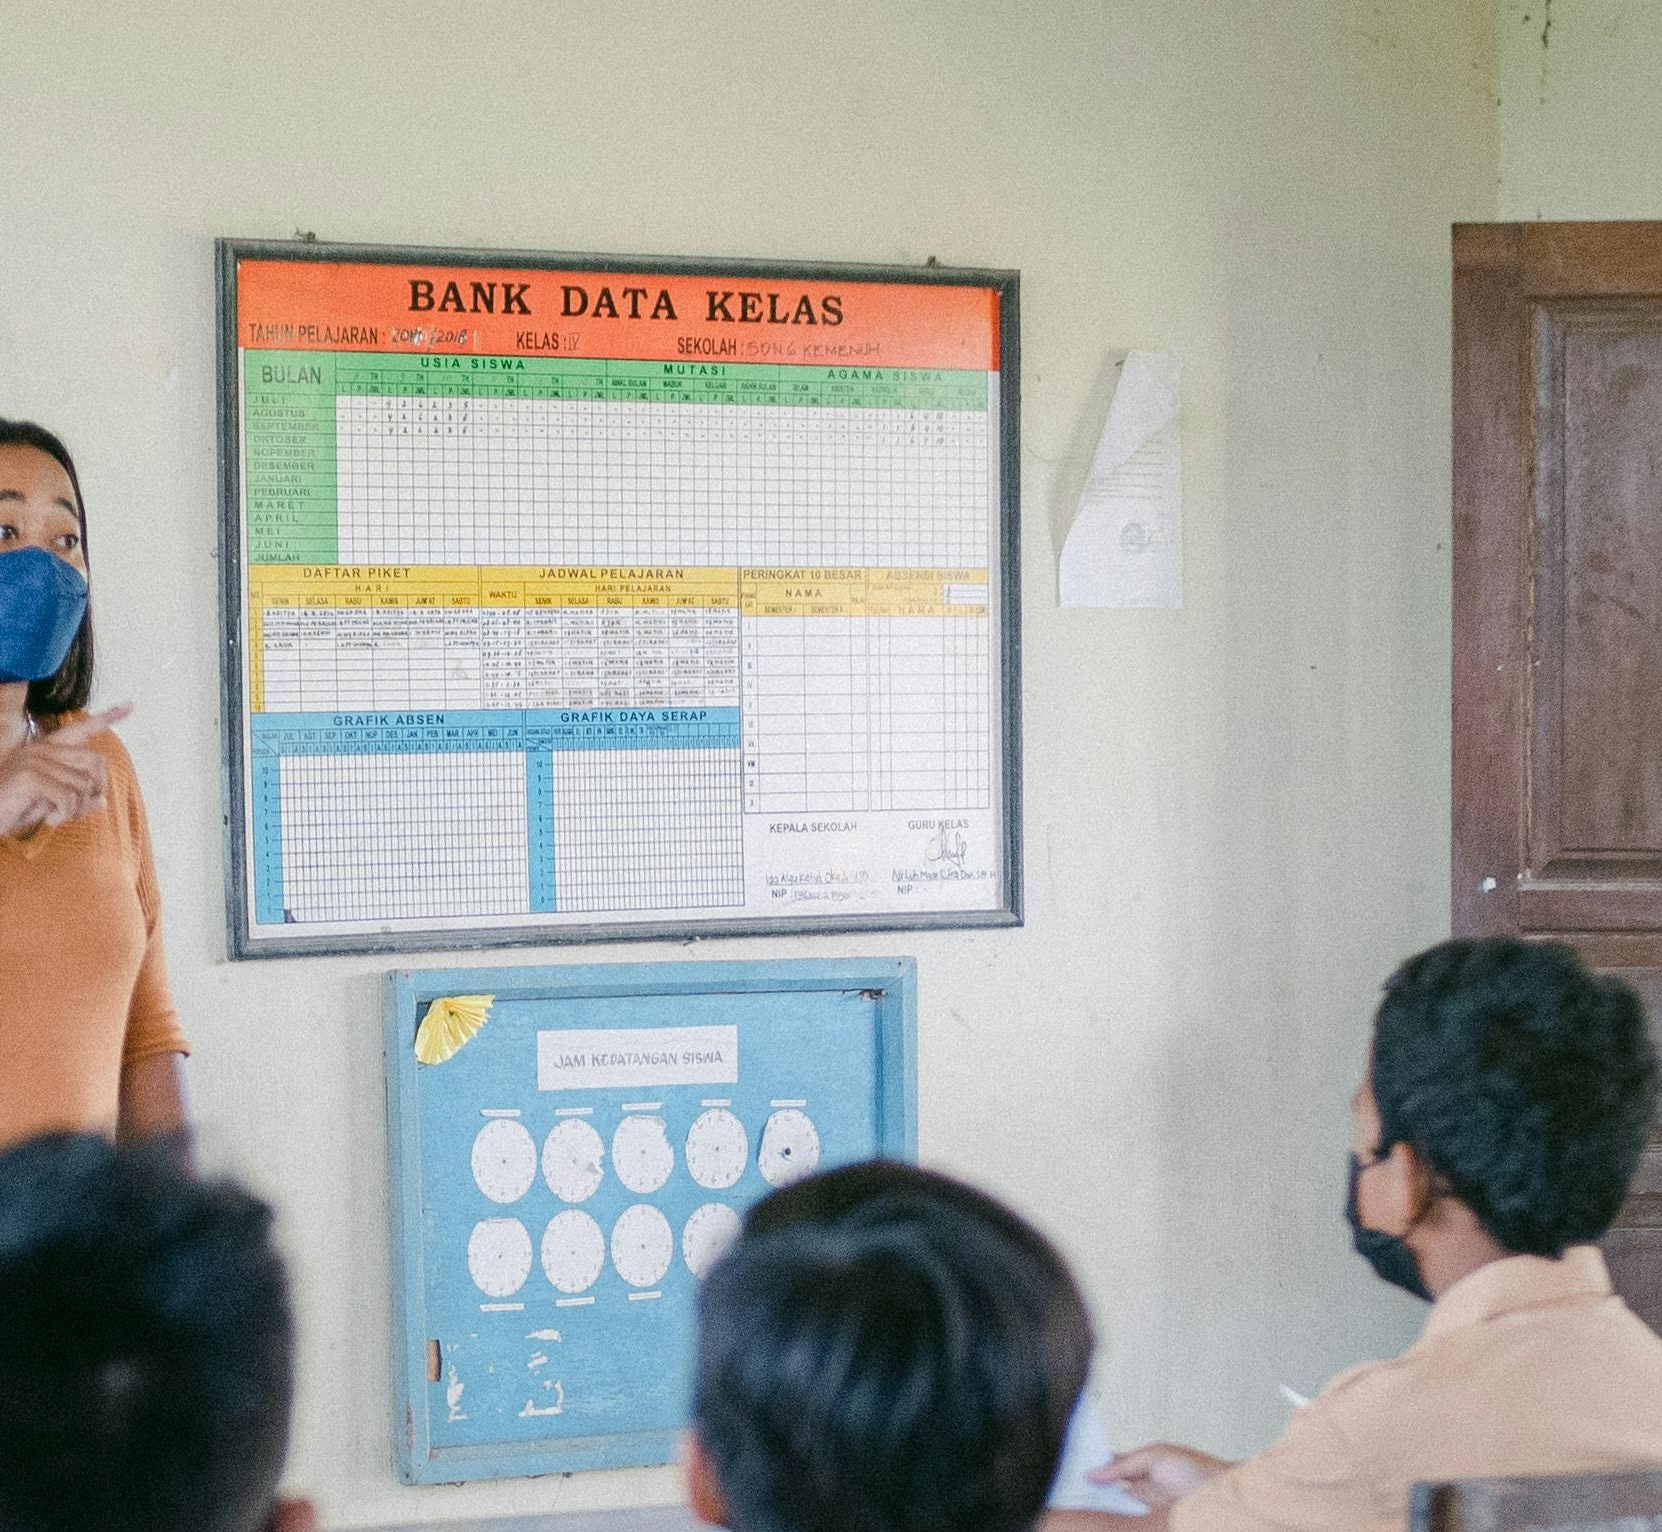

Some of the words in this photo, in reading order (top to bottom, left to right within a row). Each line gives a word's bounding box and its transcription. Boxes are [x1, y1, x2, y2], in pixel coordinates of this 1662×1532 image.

[407, 279, 533, 315] BANK
[560, 285, 679, 320] DATA
[704, 290, 844, 327] KELAS
[248, 322, 294, 344] TAHUN
[298, 324, 378, 345] PELAJARAN
[516, 331, 560, 351] KELAS
[677, 336, 737, 356] SEKOLAH
[803, 343, 881, 358] KEMENUH
[420, 357, 460, 369] USIA
[471, 359, 526, 371] SISWA
[261, 365, 322, 385] BULAN
[663, 364, 727, 376] MUTASI
[826, 369, 884, 381] AGAMA
[892, 370, 943, 382] SISWA
[252, 409, 305, 418] AGUSTUS
[254, 435, 307, 444] OKTOBER
[254, 448, 316, 457] NOPEMBER
[254, 461, 315, 470] DESEMBER
[254, 474, 303, 483] JANUARI
[254, 487, 313, 496] PEBRUARI
[254, 500, 305, 510] MARET
[254, 514, 298, 523] APRIL
[254, 527, 281, 536] MEI
[254, 540, 289, 549] JUNI
[303, 567, 361, 579] DAFTAR
[368, 567, 411, 579] PIKET
[539, 568, 596, 580] JADWAL
[599, 568, 684, 580] PELAJARAN
[742, 568, 805, 579] PERINGKAT
[810, 569, 821, 579] 10
[824, 569, 863, 580] BESAR
[354, 583, 389, 593] HARI
[594, 584, 619, 593] HARI
[620, 584, 672, 593] PELAJARAN
[784, 588, 823, 598] NAMA
[488, 590, 518, 600] WAKTU
[333, 715, 389, 726] GRAFIK
[395, 713, 445, 726] ABSEN
[560, 712, 614, 723] GRAFIK
[619, 711, 656, 722] DAYA
[661, 711, 707, 721] SERAP
[769, 822, 808, 833] KEPALA
[811, 820, 857, 832] SEKOLAH
[907, 819, 936, 830] GURU
[937, 819, 970, 830] KELAS
[771, 889, 787, 899] NIP
[897, 884, 913, 895] NIP
[553, 1052, 585, 1070] JAM
[590, 1050, 678, 1069] KEDATANGAN
[682, 1048, 724, 1067] SISWA
